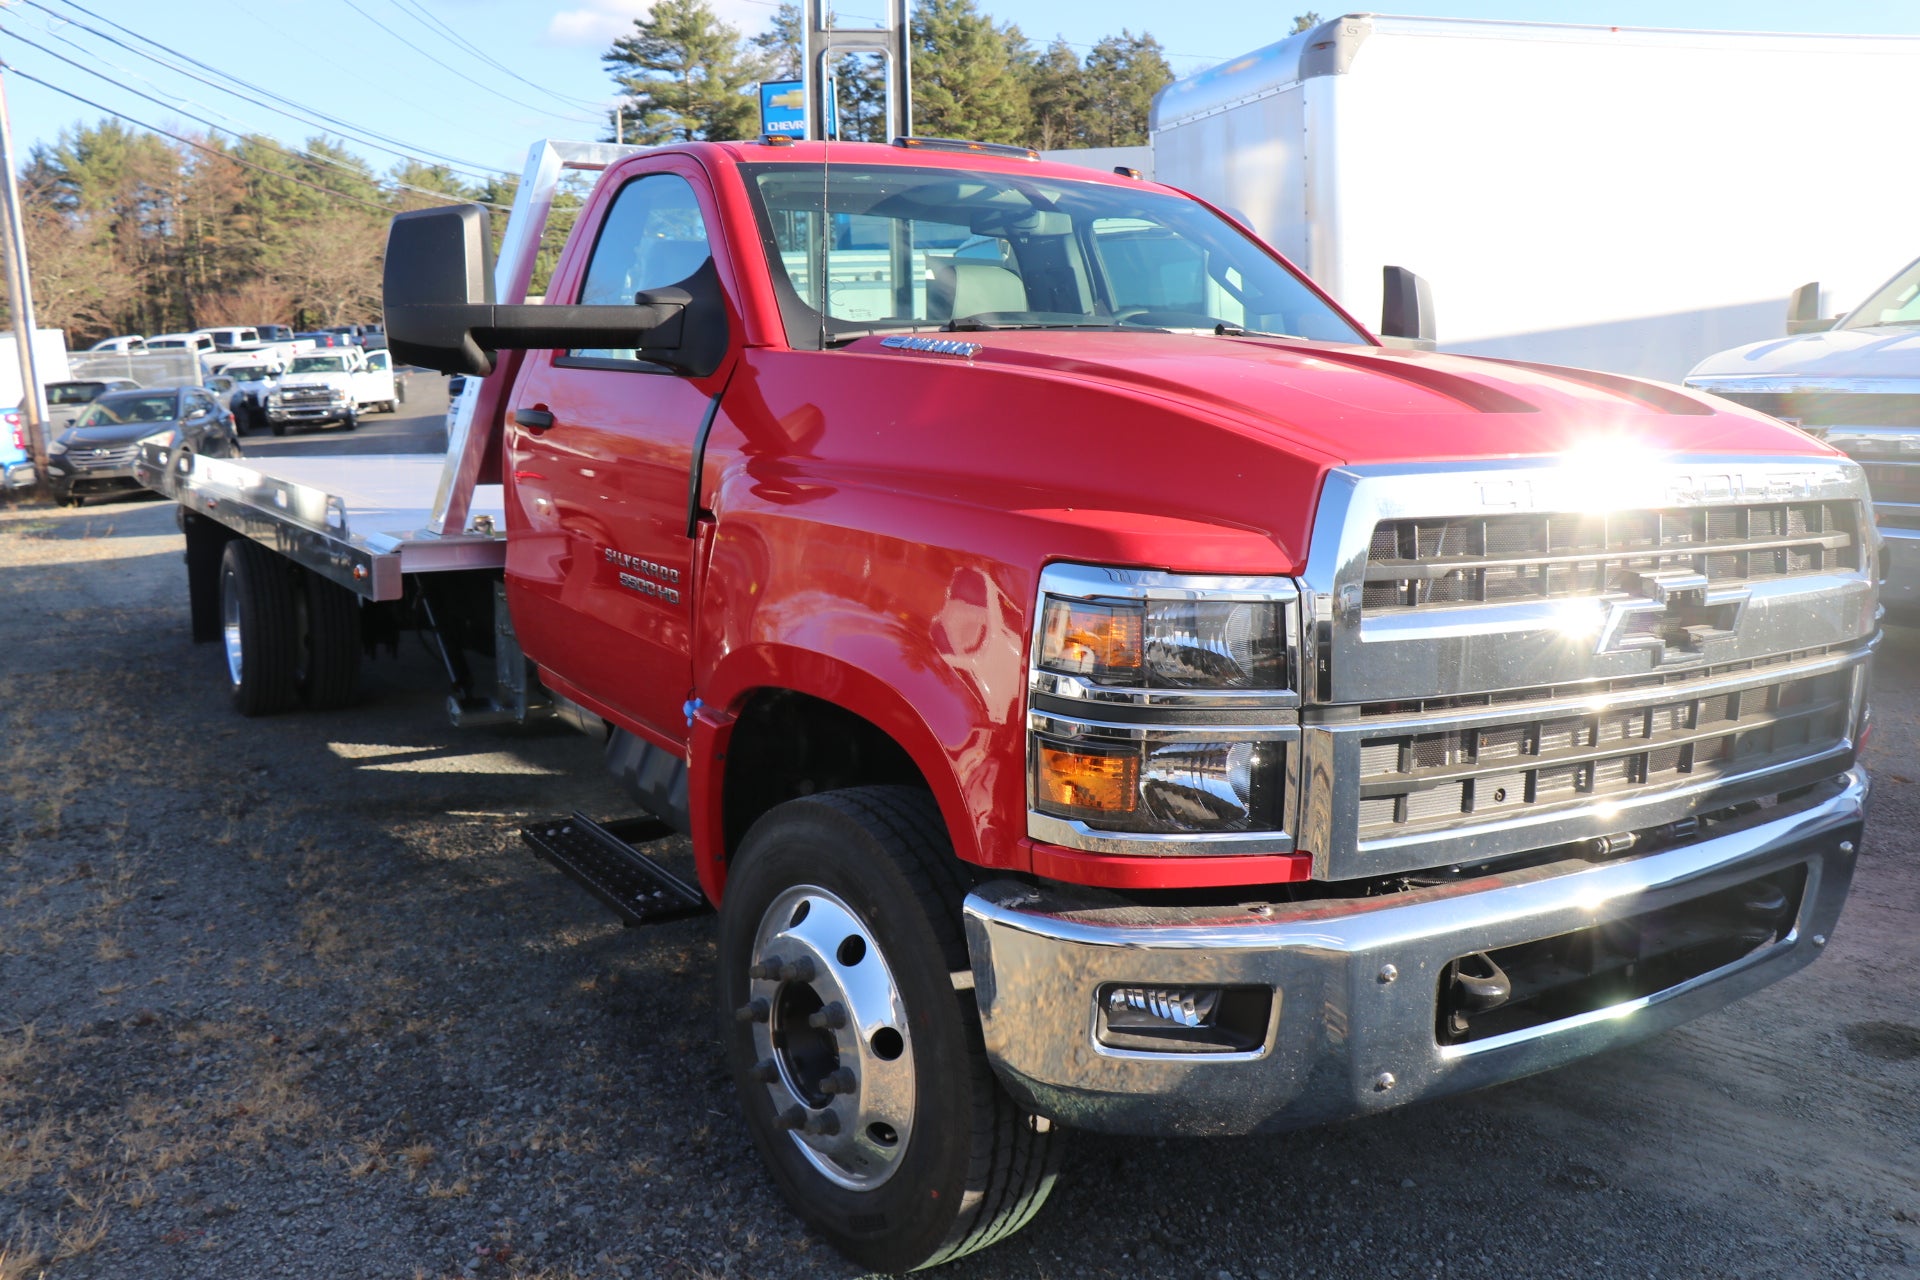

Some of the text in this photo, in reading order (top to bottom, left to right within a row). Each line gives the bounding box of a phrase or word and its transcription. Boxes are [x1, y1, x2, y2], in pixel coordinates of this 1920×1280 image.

[767, 120, 805, 131] CHEVR
[1473, 471, 1818, 508] CROLET
[604, 547, 680, 583] SILVERADO
